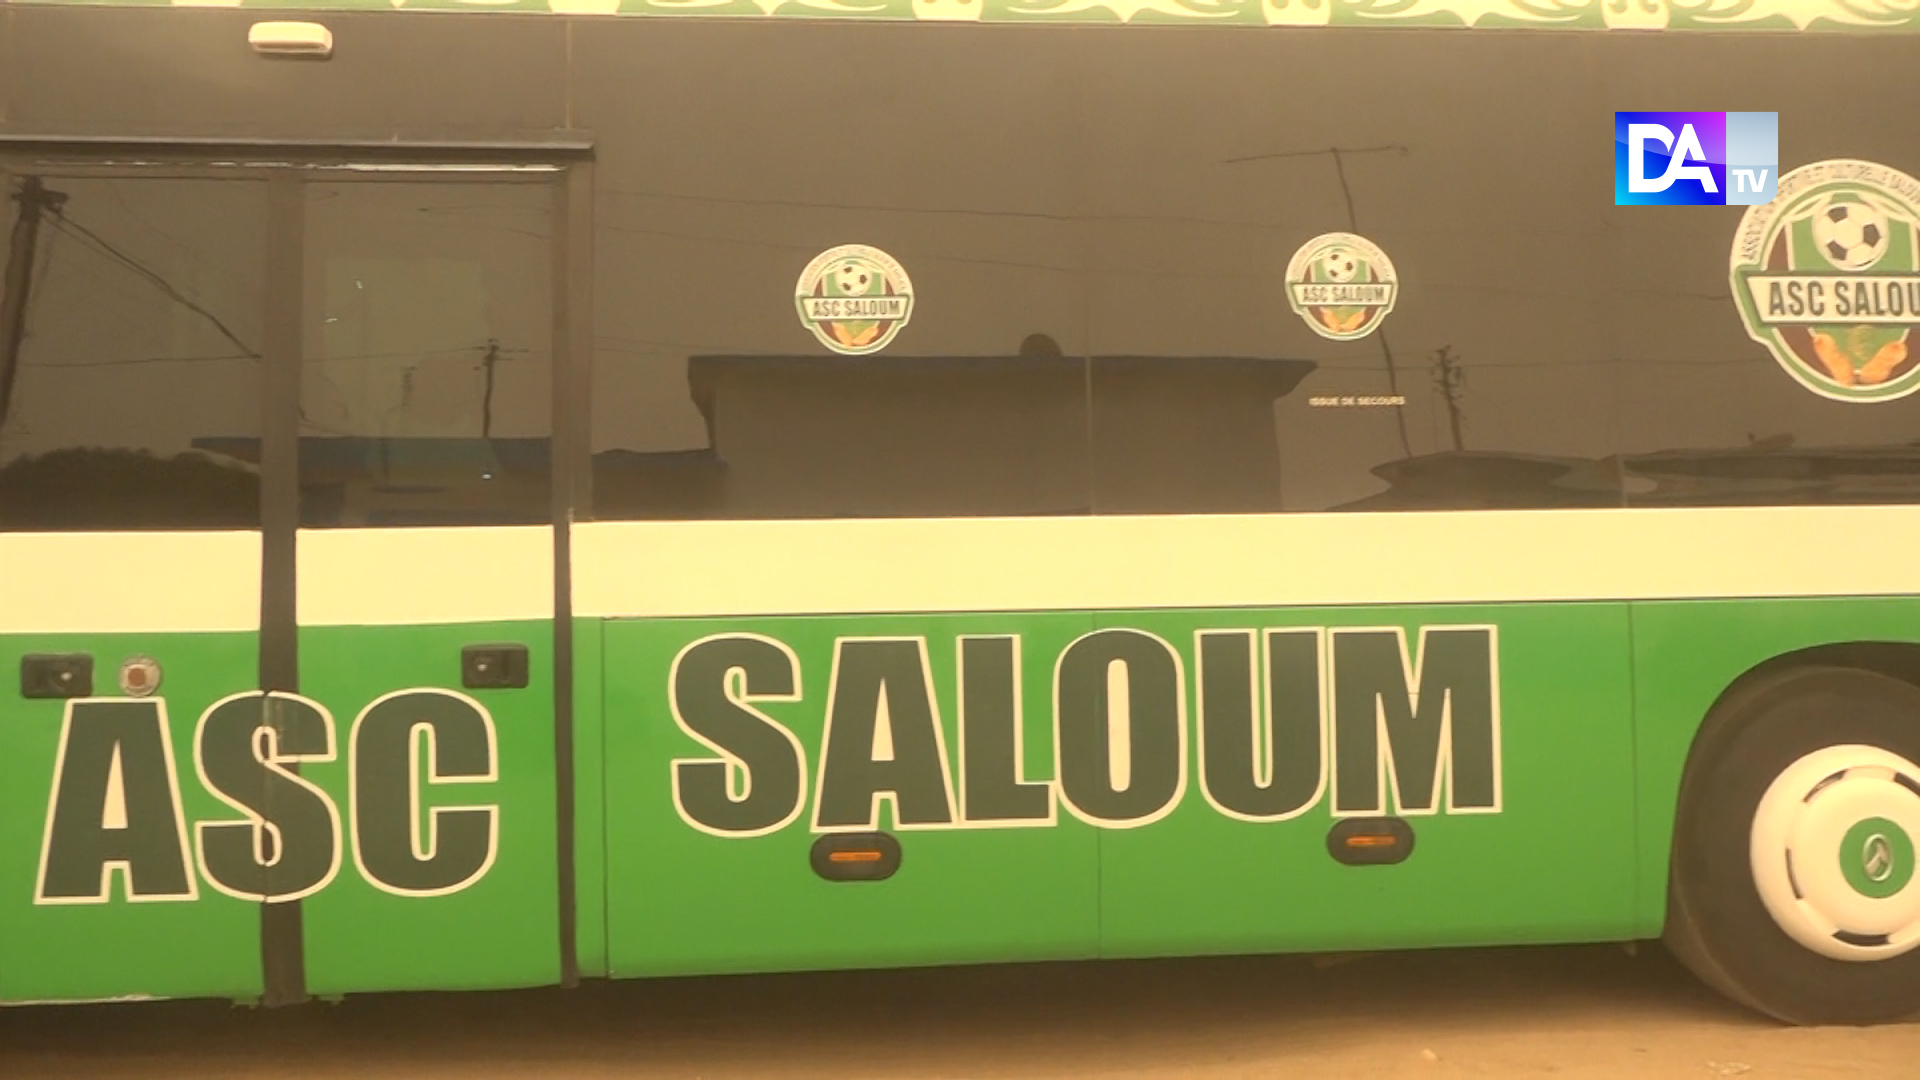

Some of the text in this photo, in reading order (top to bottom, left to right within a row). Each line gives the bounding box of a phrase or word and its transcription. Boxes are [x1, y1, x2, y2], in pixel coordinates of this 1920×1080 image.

[1303, 286, 1385, 303] ASC SALOUM
[1769, 281, 1825, 316] ASC
[813, 300, 900, 317] ASC SALOUM
[1340, 396, 1355, 406] DE
[1357, 396, 1405, 406] SECOURS
[33, 624, 1502, 905] ASC SALOUM
